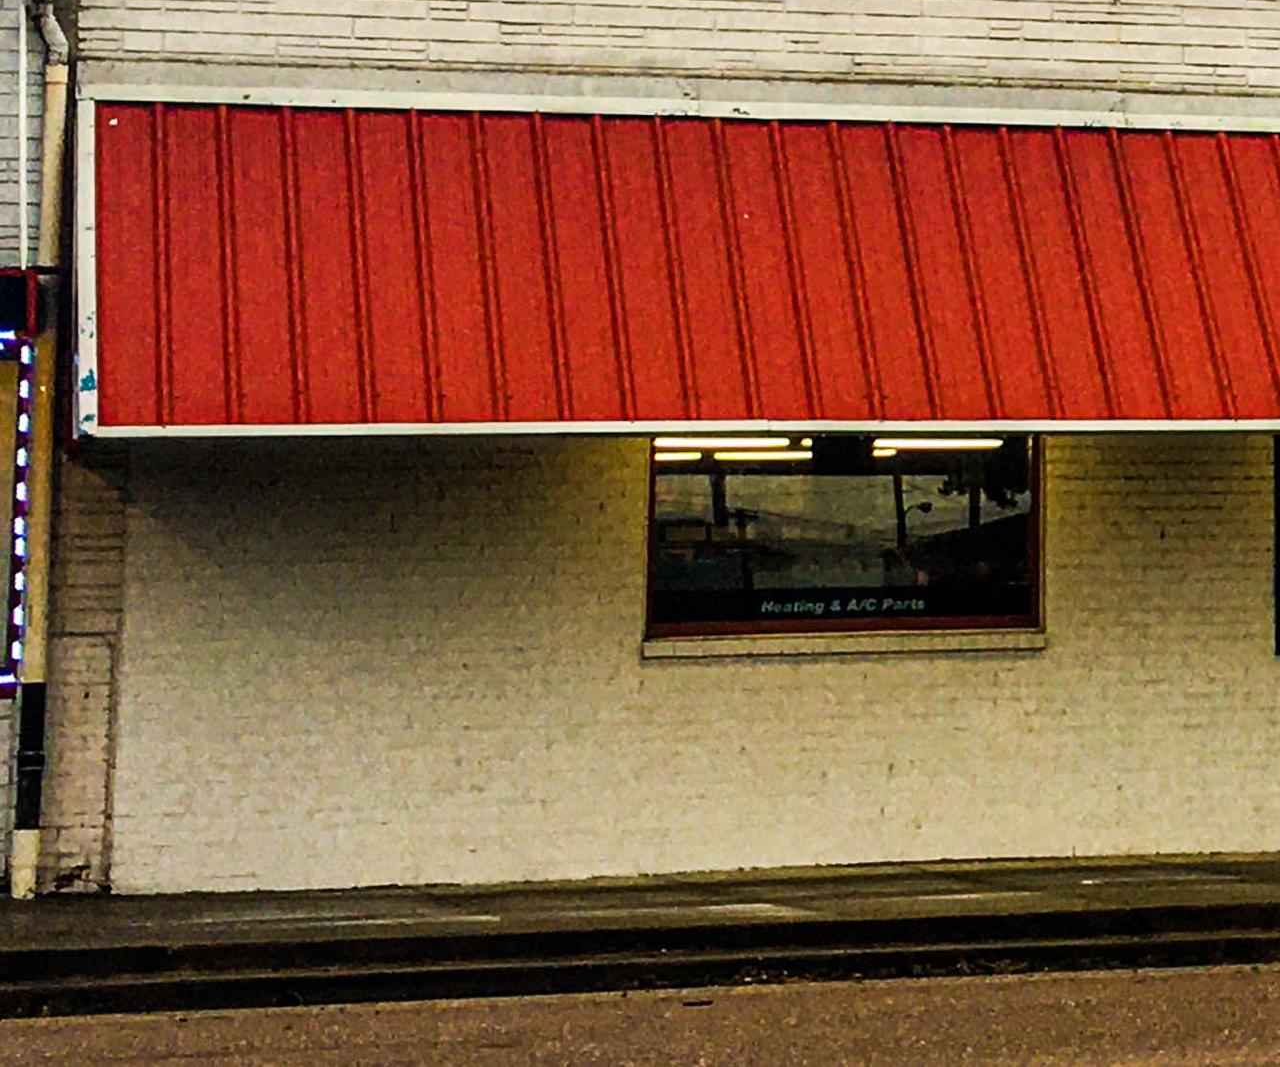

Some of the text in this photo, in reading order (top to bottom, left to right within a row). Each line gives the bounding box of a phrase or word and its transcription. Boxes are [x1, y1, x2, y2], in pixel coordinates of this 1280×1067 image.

[761, 598, 926, 615] Heating & A/C Parts
